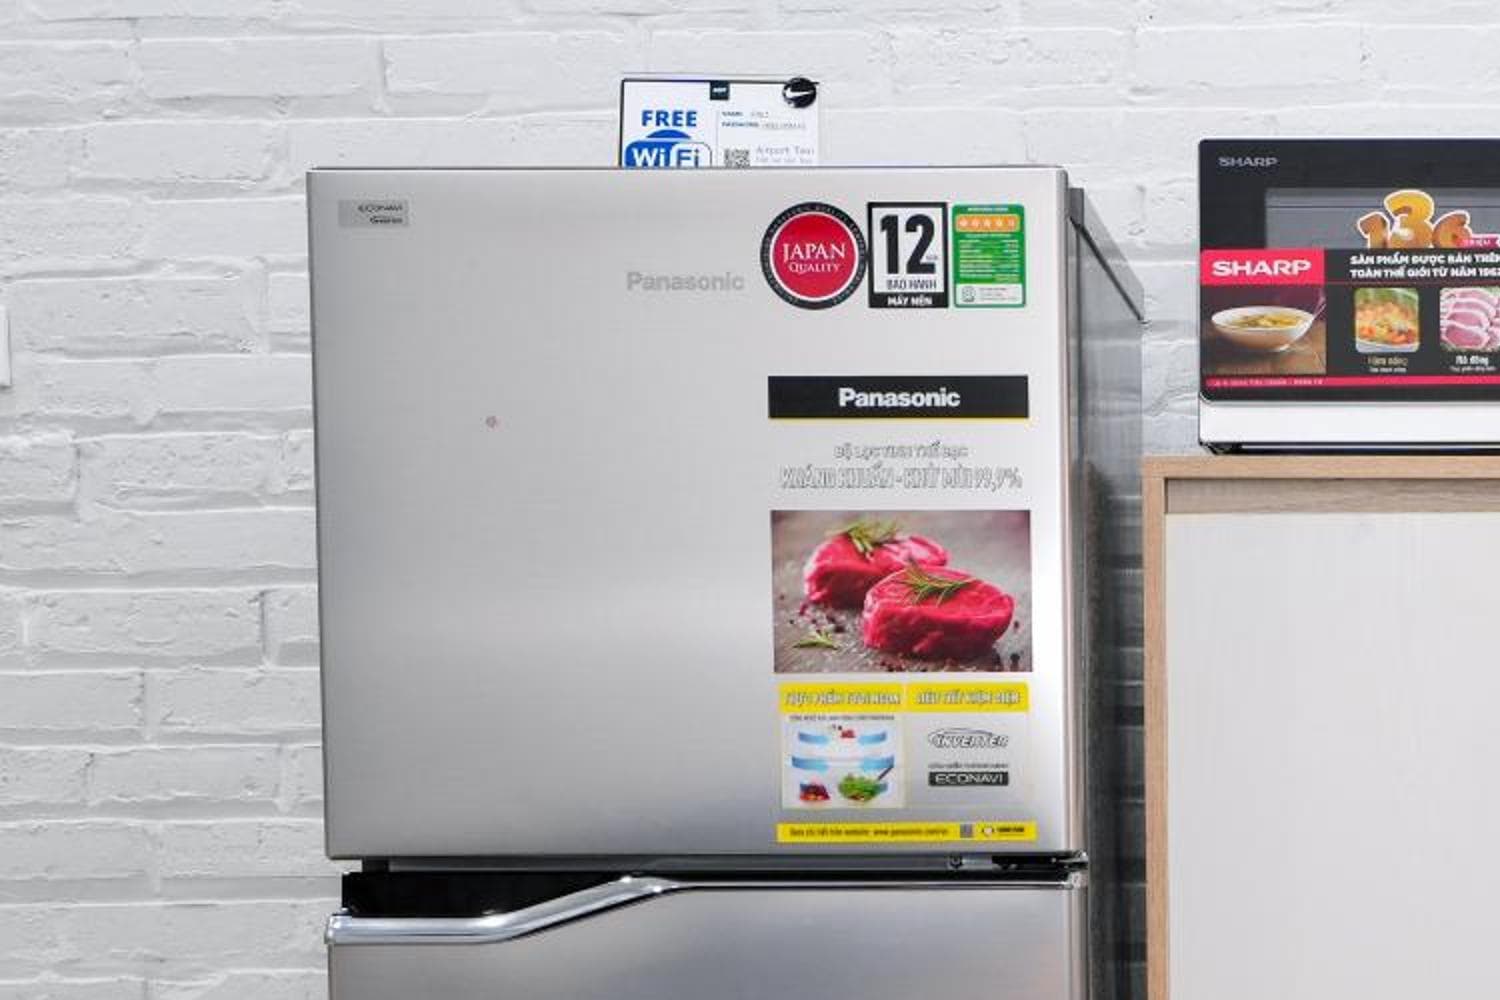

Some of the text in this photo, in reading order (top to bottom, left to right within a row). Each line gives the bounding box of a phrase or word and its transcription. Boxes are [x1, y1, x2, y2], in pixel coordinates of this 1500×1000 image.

[641, 110, 697, 127] FREE
[1218, 157, 1278, 167] SHARP
[783, 242, 846, 263] JAPAN
[880, 213, 936, 275] 12
[789, 263, 840, 275] QUALITY
[1212, 259, 1312, 277] SHARP
[626, 271, 745, 291] Panasonic
[838, 387, 961, 408] Panasonic
[935, 773, 1003, 784] ECONAVI
